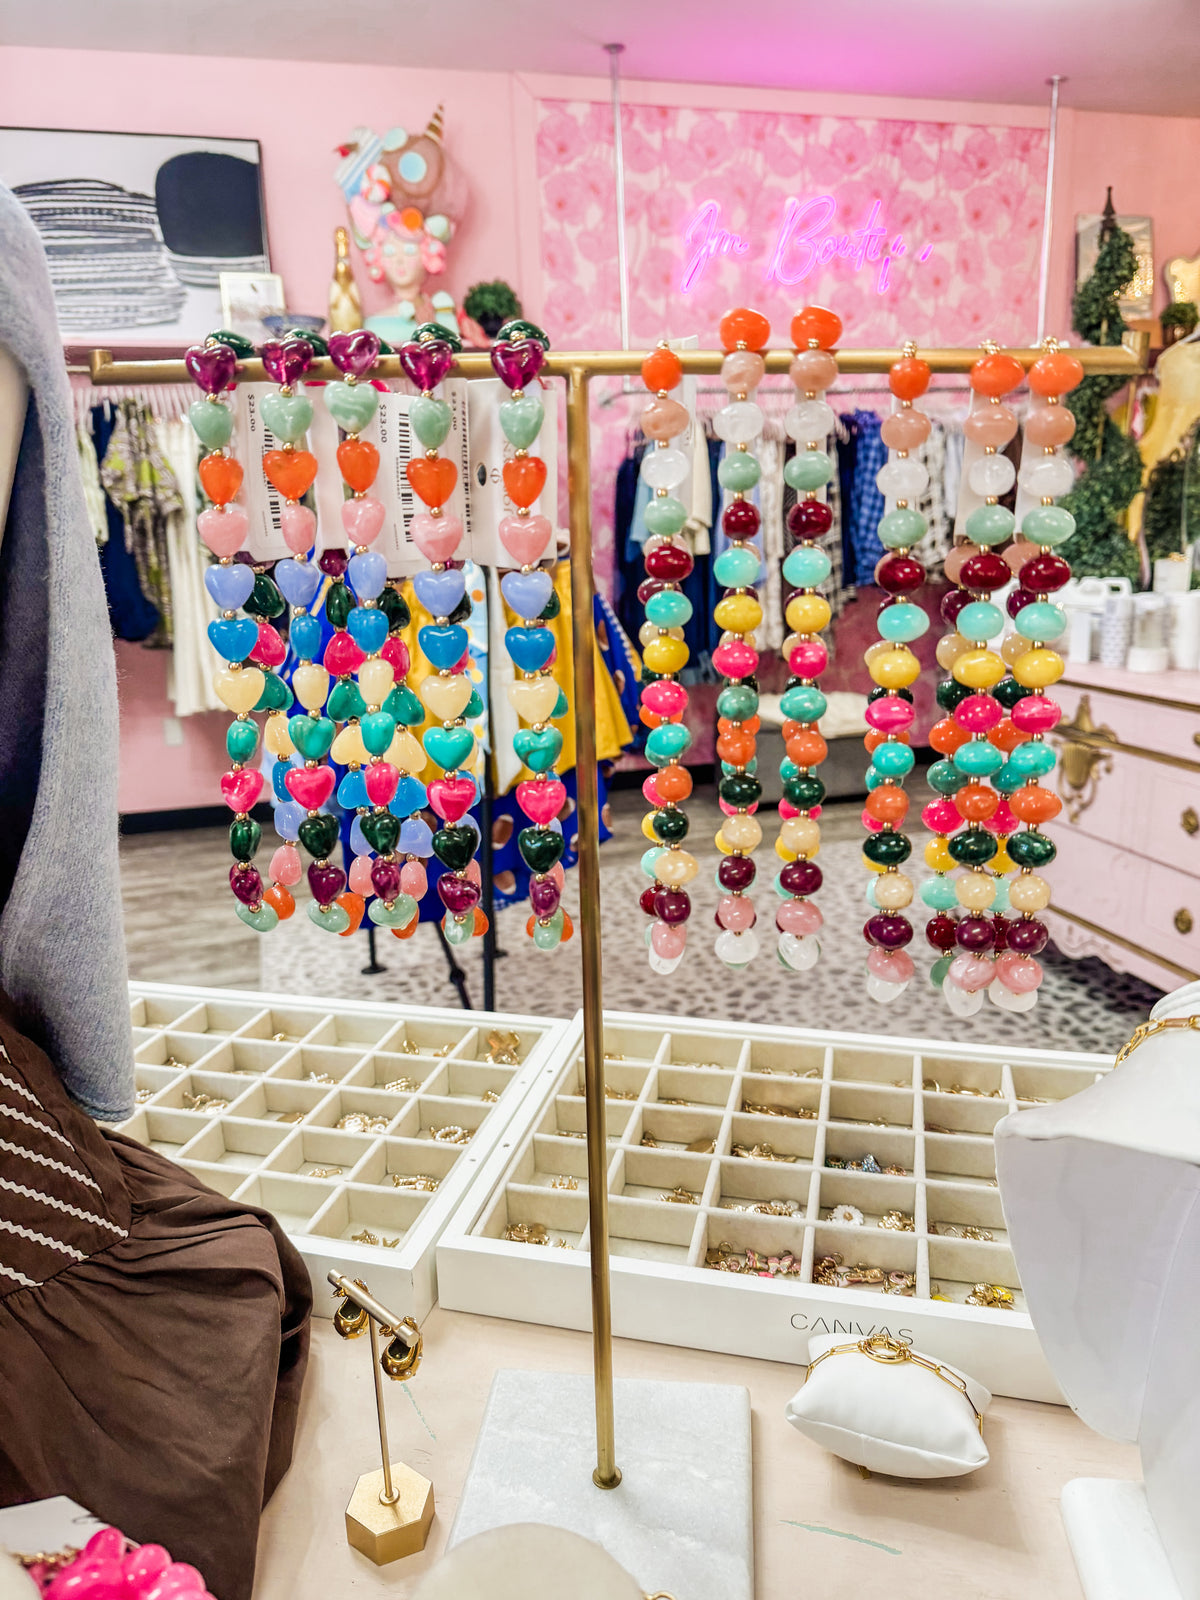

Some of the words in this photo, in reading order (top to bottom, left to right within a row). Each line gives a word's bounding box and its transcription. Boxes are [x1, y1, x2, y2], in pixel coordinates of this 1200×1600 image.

[767, 194, 934, 295] Bouti
[247, 393, 256, 432] $23.00
[378, 404, 388, 444] $23.00
[790, 1313, 914, 1346] CANVAS
